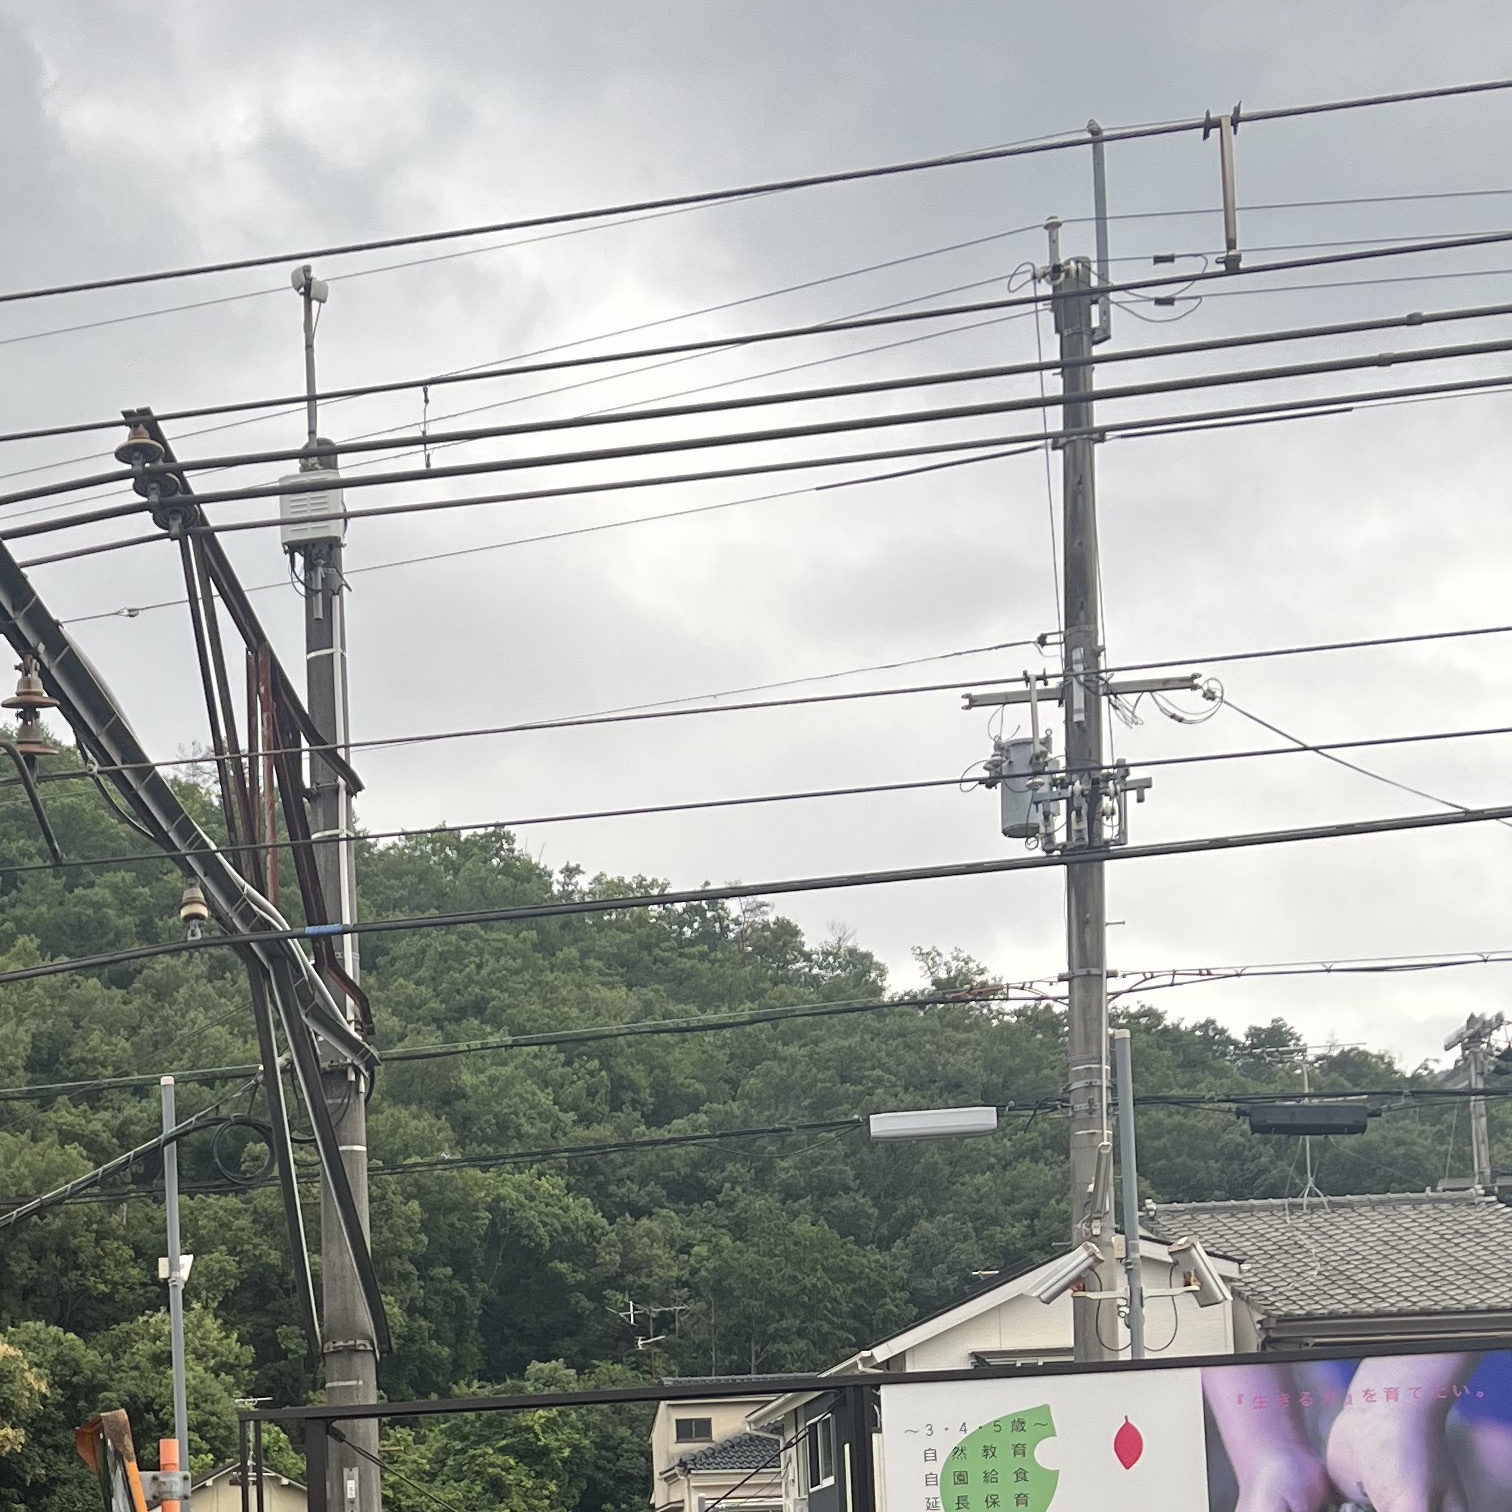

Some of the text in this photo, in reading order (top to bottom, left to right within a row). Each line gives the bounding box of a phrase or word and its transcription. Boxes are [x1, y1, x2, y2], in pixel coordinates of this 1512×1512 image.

[923, 1442, 1028, 1462] 自然教育
[924, 1466, 1030, 1487] 自園給食
[924, 1492, 1030, 1512] 延長保育
